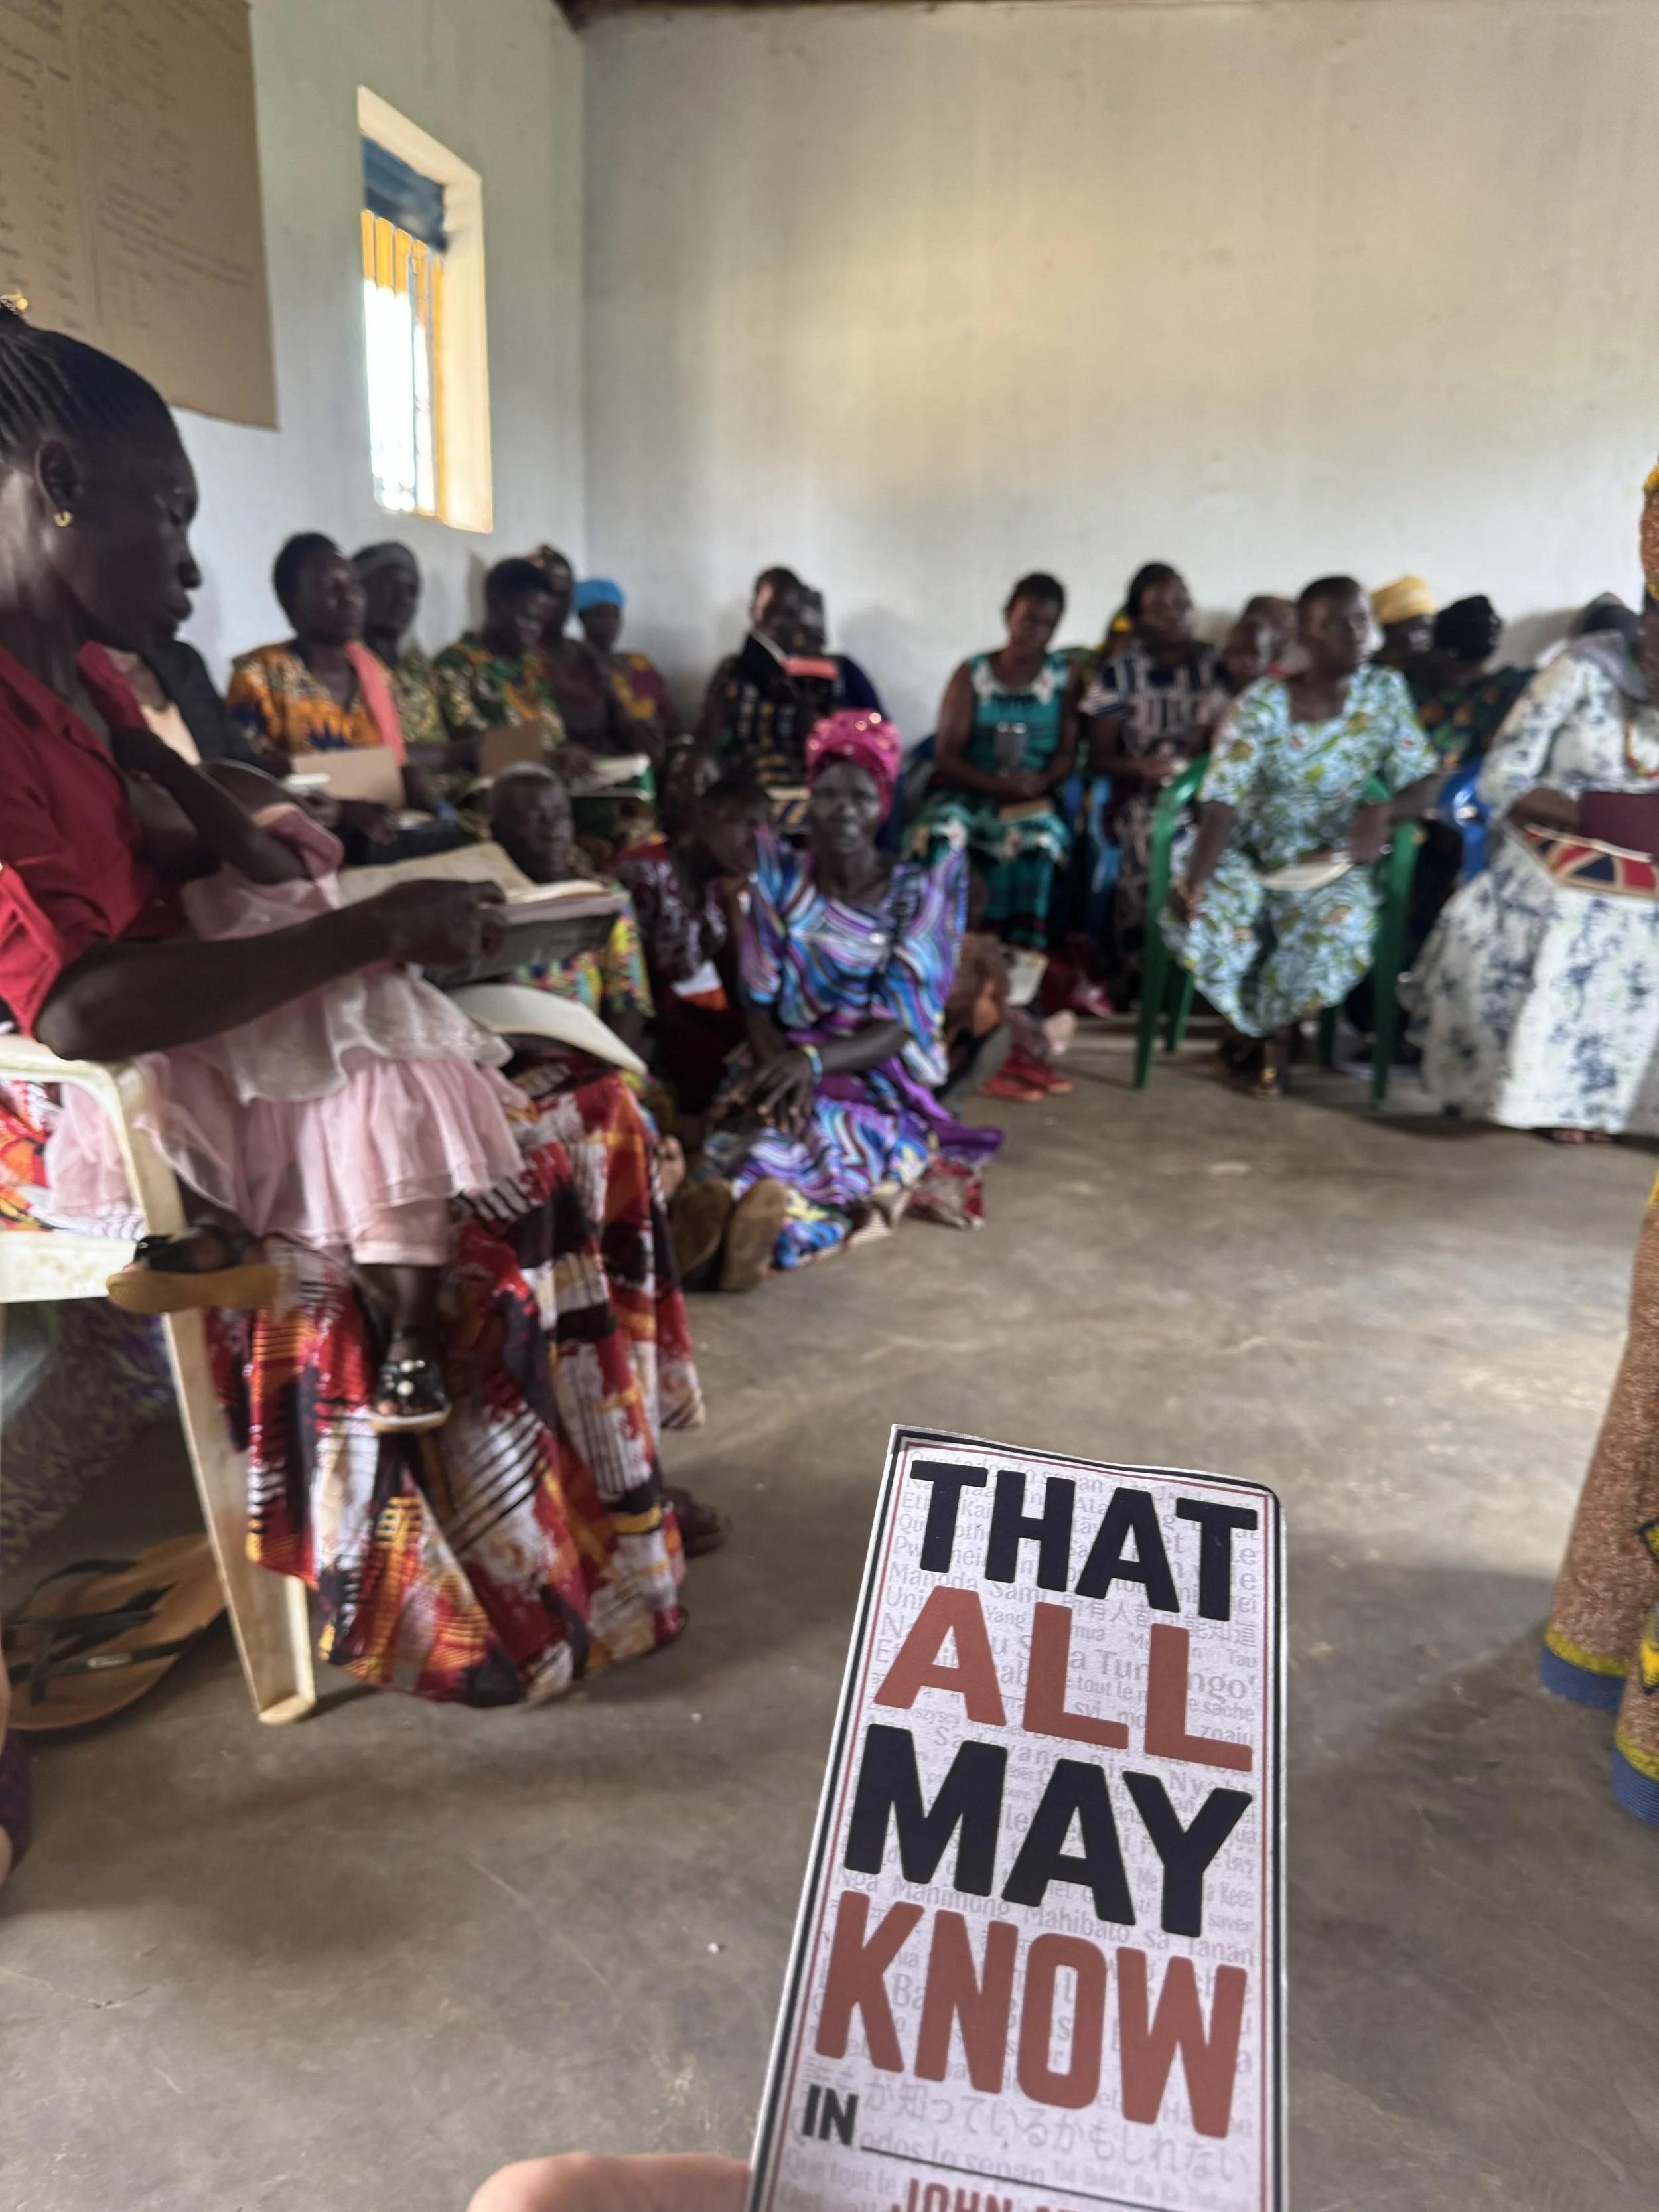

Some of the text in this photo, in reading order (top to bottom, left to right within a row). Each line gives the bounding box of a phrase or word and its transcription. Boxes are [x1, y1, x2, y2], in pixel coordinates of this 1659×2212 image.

[909, 1459, 1258, 1622] THAT
[873, 1586, 1252, 1772] ALL
[843, 1723, 1253, 1938] MAY
[815, 1891, 1248, 2138] KNOW
[802, 2084, 859, 2147] IN
